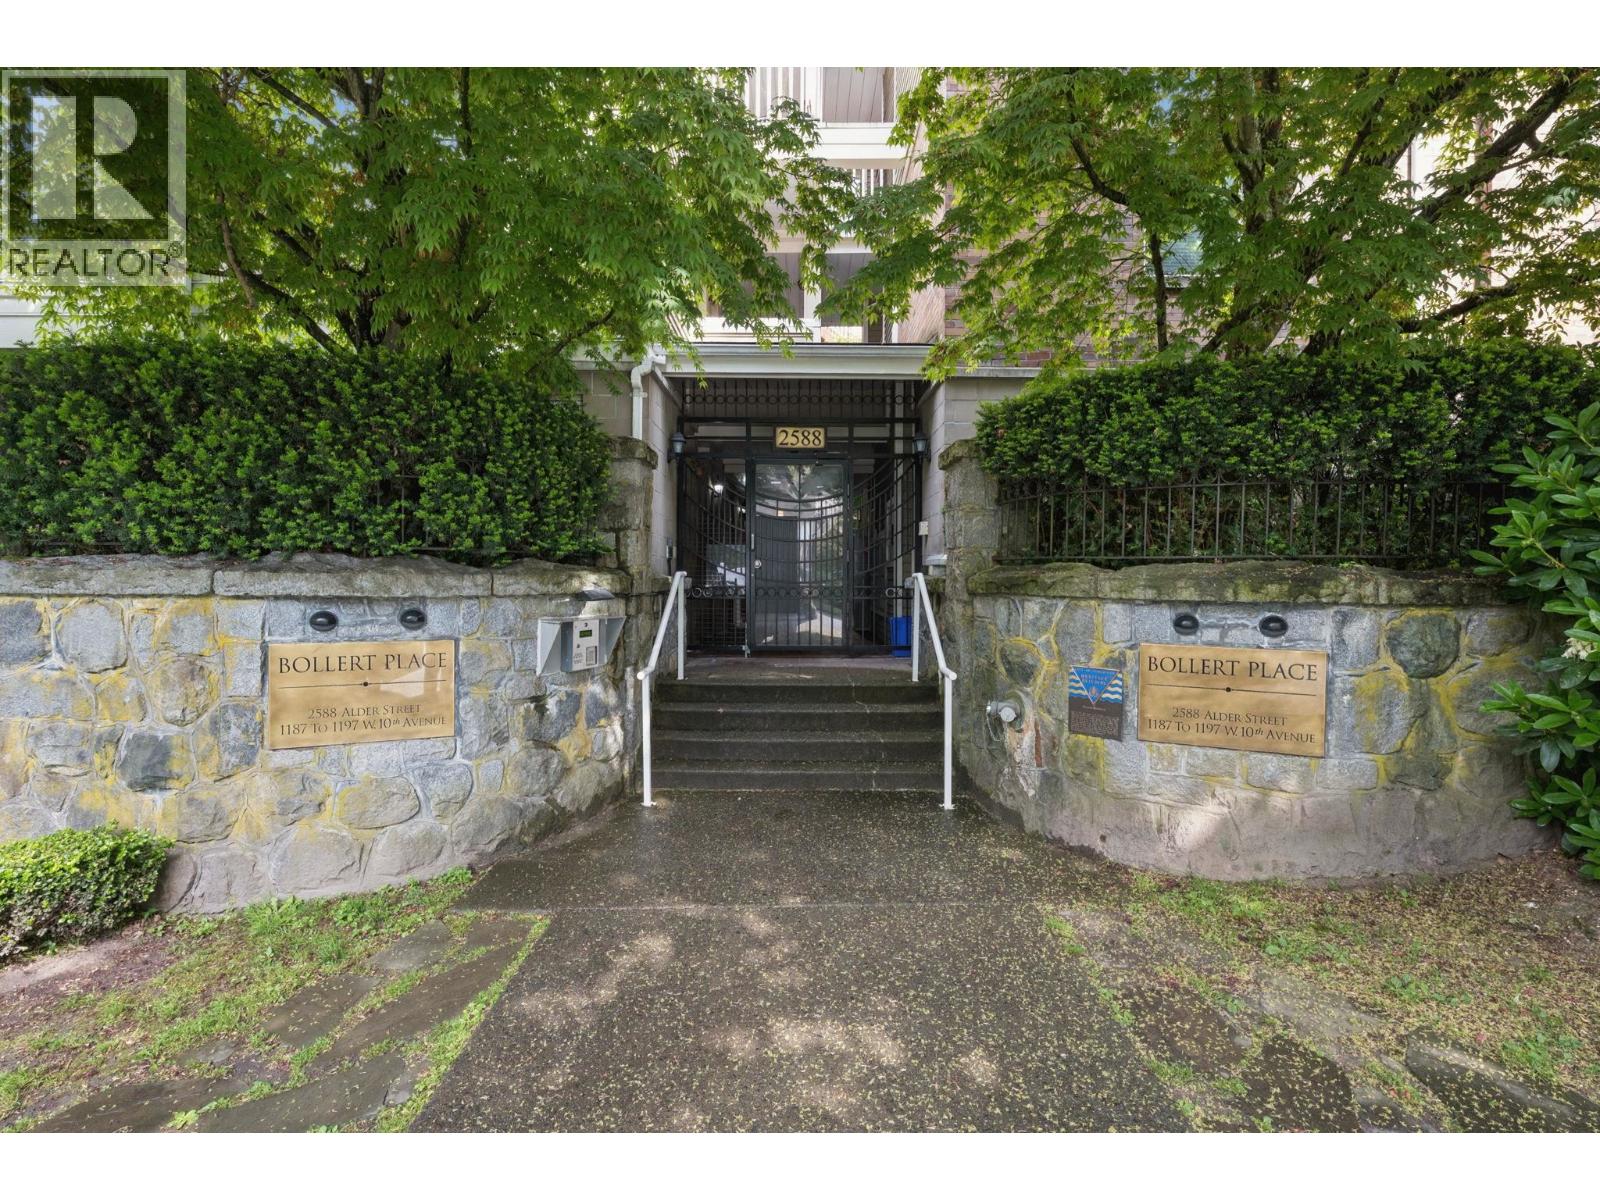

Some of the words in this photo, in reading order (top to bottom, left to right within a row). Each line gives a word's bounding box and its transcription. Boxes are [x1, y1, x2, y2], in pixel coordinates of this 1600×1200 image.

[779, 429, 821, 446] 2588
[279, 655, 376, 674] BOLLERT
[385, 652, 447, 670] PLACE
[1148, 656, 1240, 676] BOLLERT
[1249, 661, 1318, 681] PLACE
[308, 708, 337, 720] 2588
[341, 706, 379, 717] ALDER
[383, 704, 422, 714] STREET
[1172, 707, 1200, 719] 2588
[1204, 710, 1242, 722] ALDER
[1245, 713, 1288, 726] STREET
[280, 723, 307, 736] 1187
[333, 720, 359, 732] 1197
[402, 716, 447, 727] AVENUE
[1147, 718, 1172, 730] 1187
[1195, 722, 1221, 734] 1197
[1241, 726, 1264, 738] 10th
[1266, 728, 1316, 743] AVENUE
